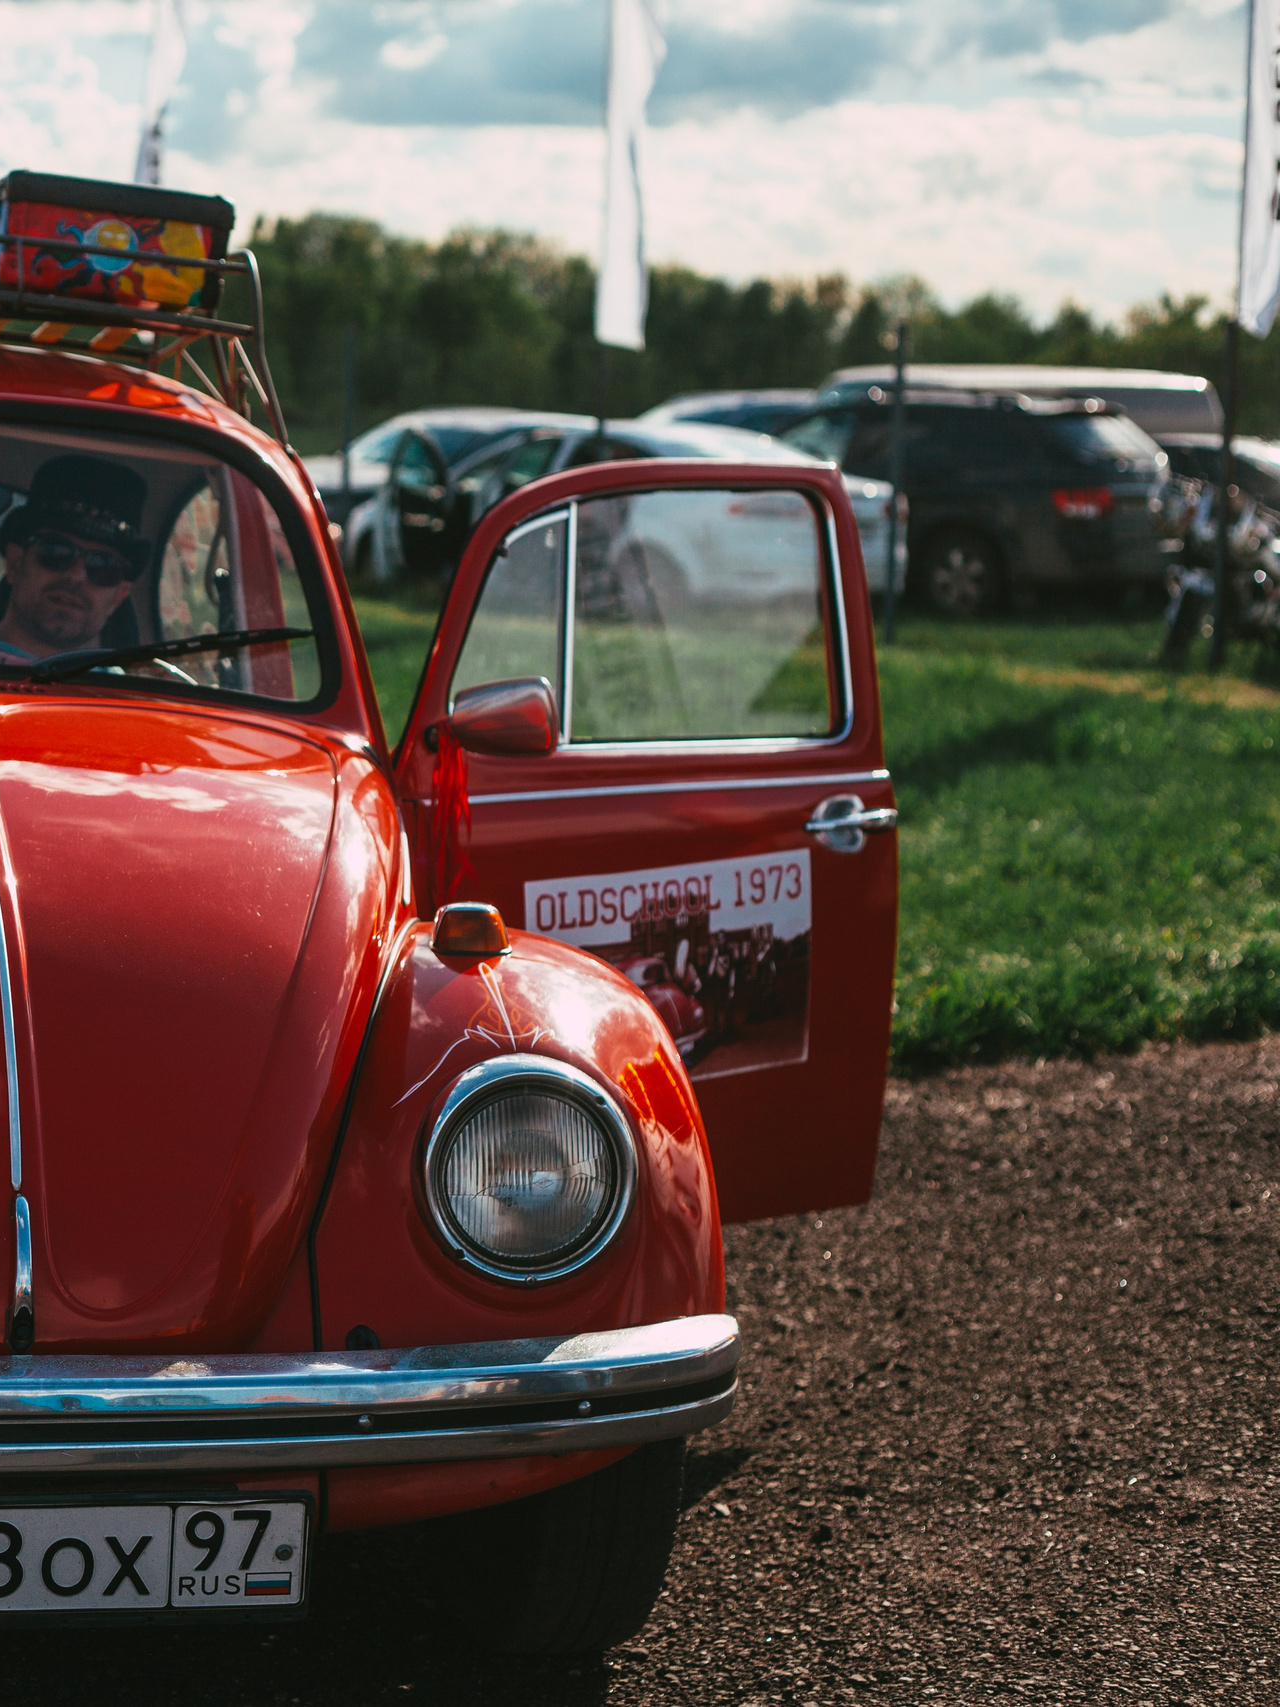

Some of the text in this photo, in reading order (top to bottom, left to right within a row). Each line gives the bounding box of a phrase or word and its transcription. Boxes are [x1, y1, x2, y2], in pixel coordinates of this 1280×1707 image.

[536, 863, 802, 931] OLDSCHOOL 1973
[185, 1511, 272, 1571] 97
[178, 1574, 241, 1596] RUS
